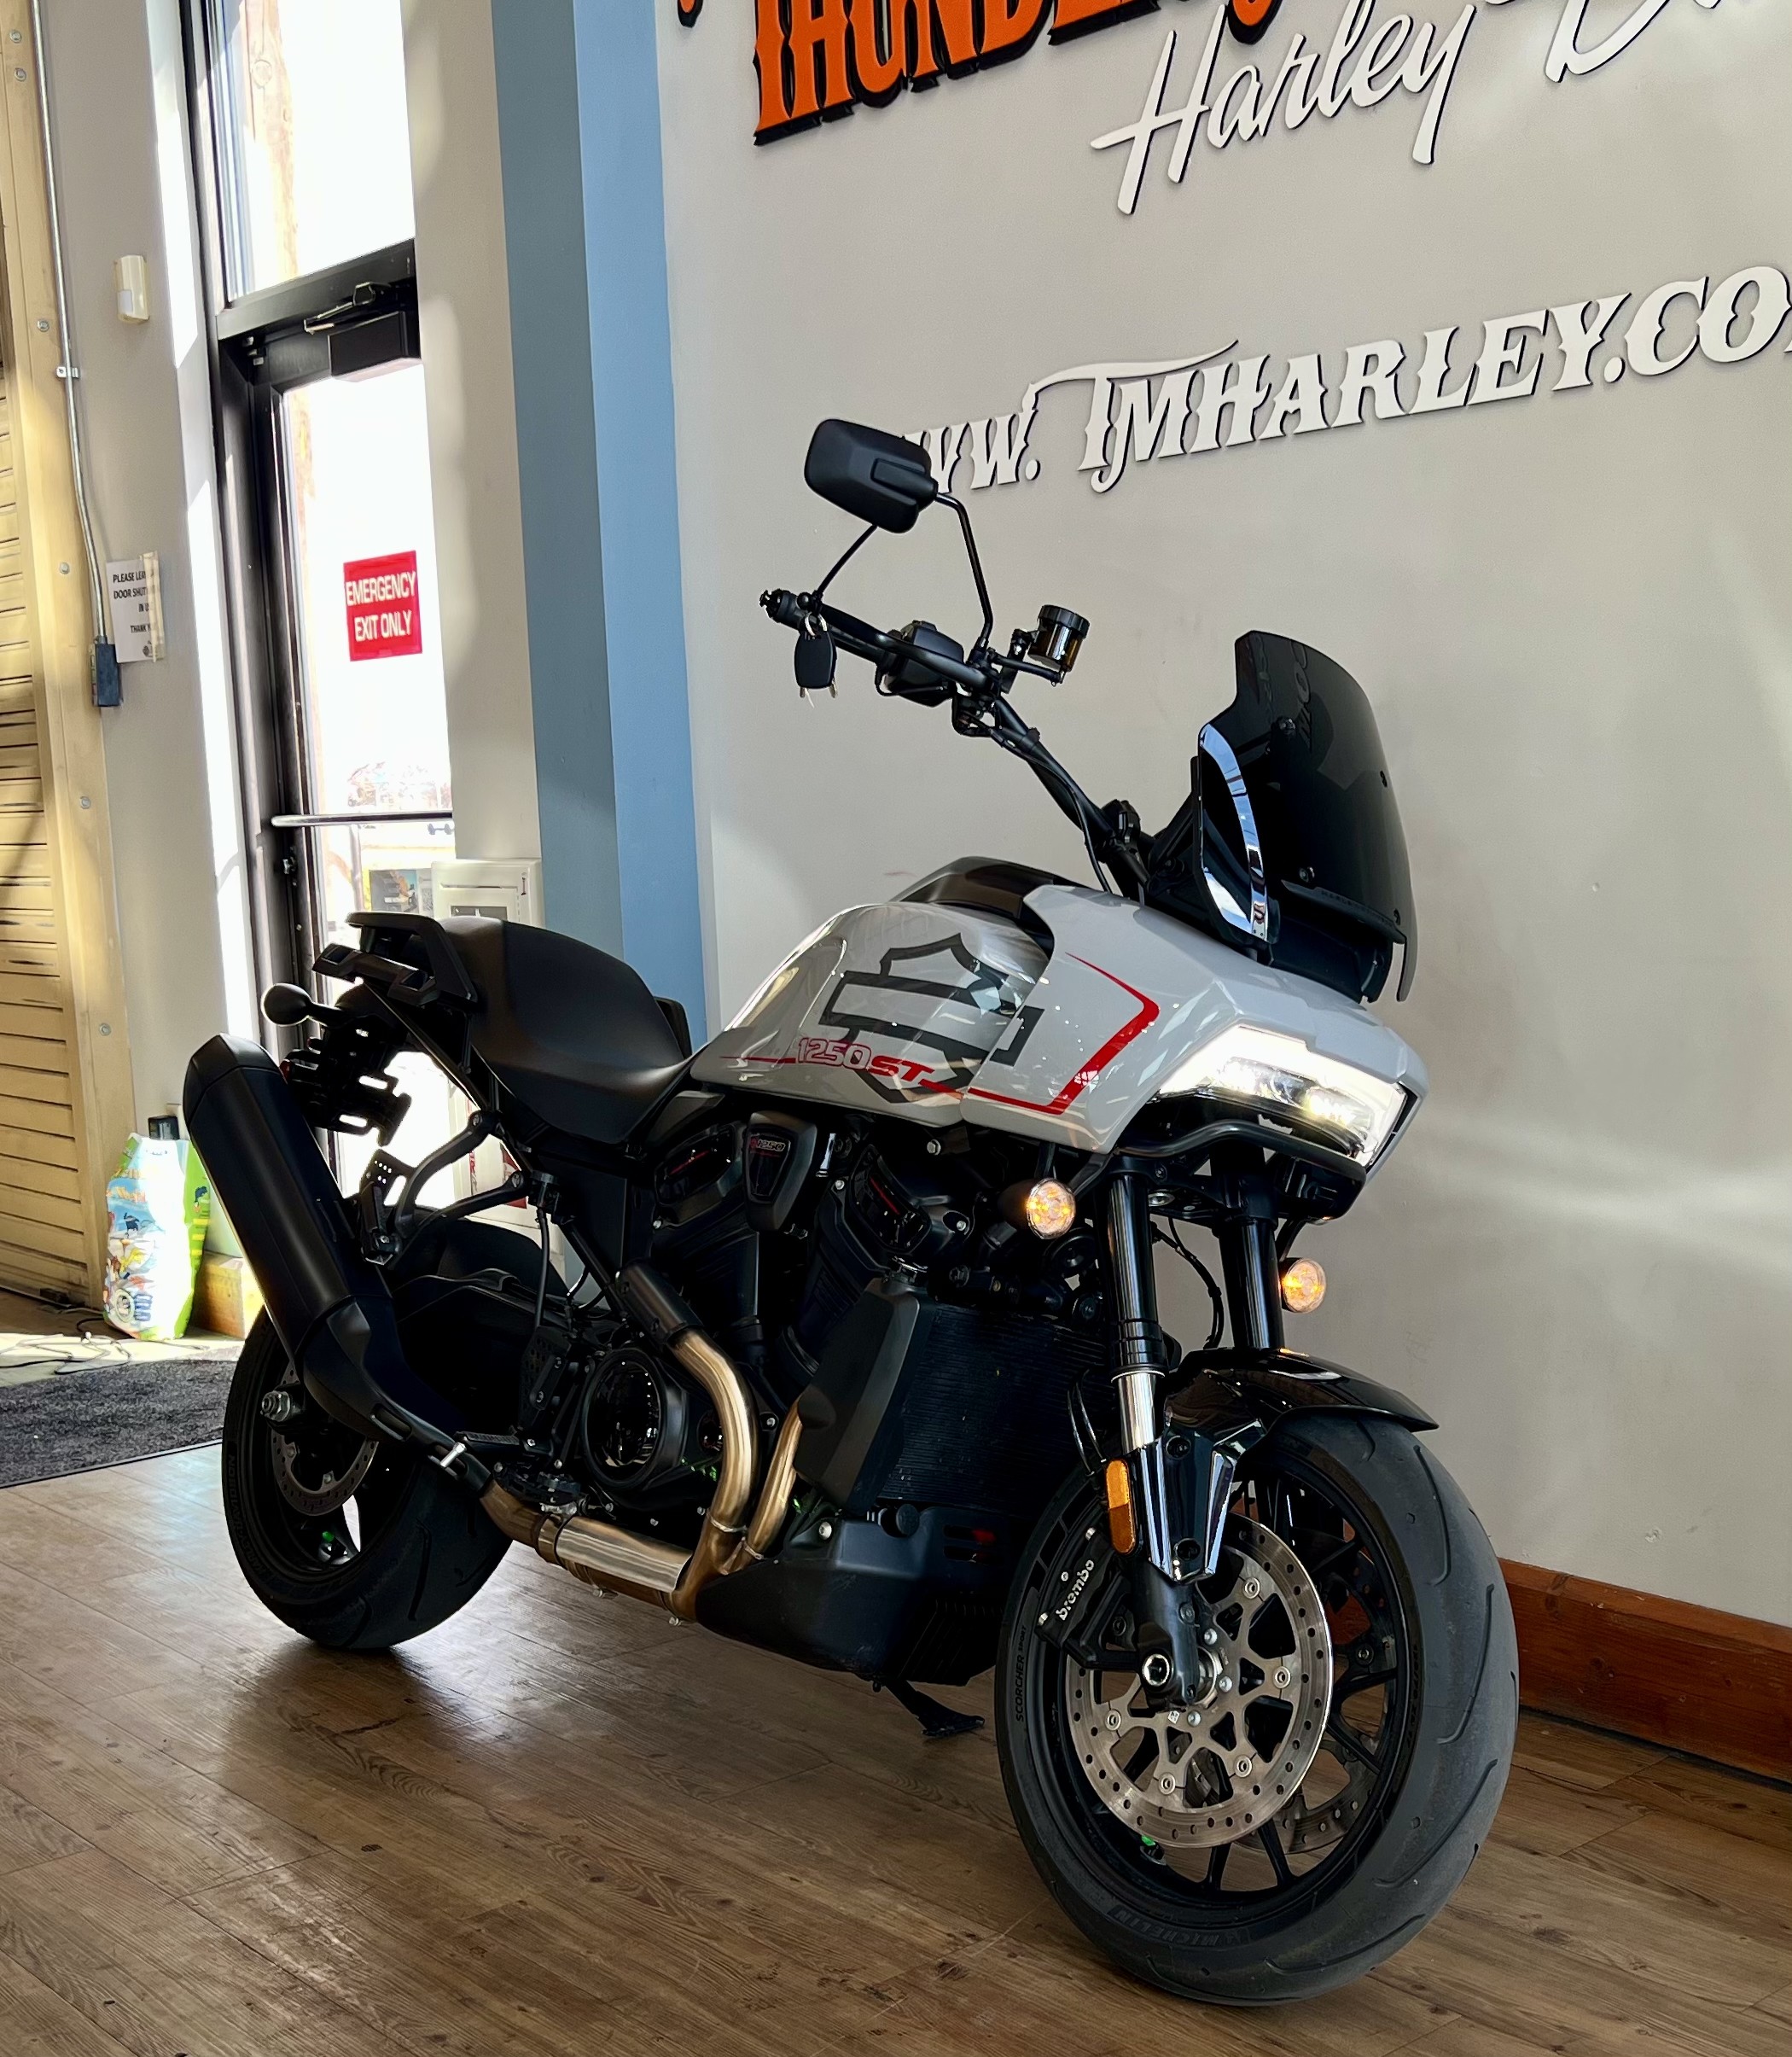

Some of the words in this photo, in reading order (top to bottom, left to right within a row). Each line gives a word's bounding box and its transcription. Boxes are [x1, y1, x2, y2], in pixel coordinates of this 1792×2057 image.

[113, 572, 135, 584] PLEASE
[135, 570, 147, 581] LEA
[113, 589, 132, 600] DOOR
[132, 587, 147, 597] SHUT
[346, 570, 416, 607] EMERGENCY
[130, 624, 147, 634] THANK
[354, 615, 379, 643] EXIT
[381, 609, 412, 638] ONLY
[1055, 1559, 1095, 1622] brembo
[1015, 1654, 1024, 1722] SCORCHER
